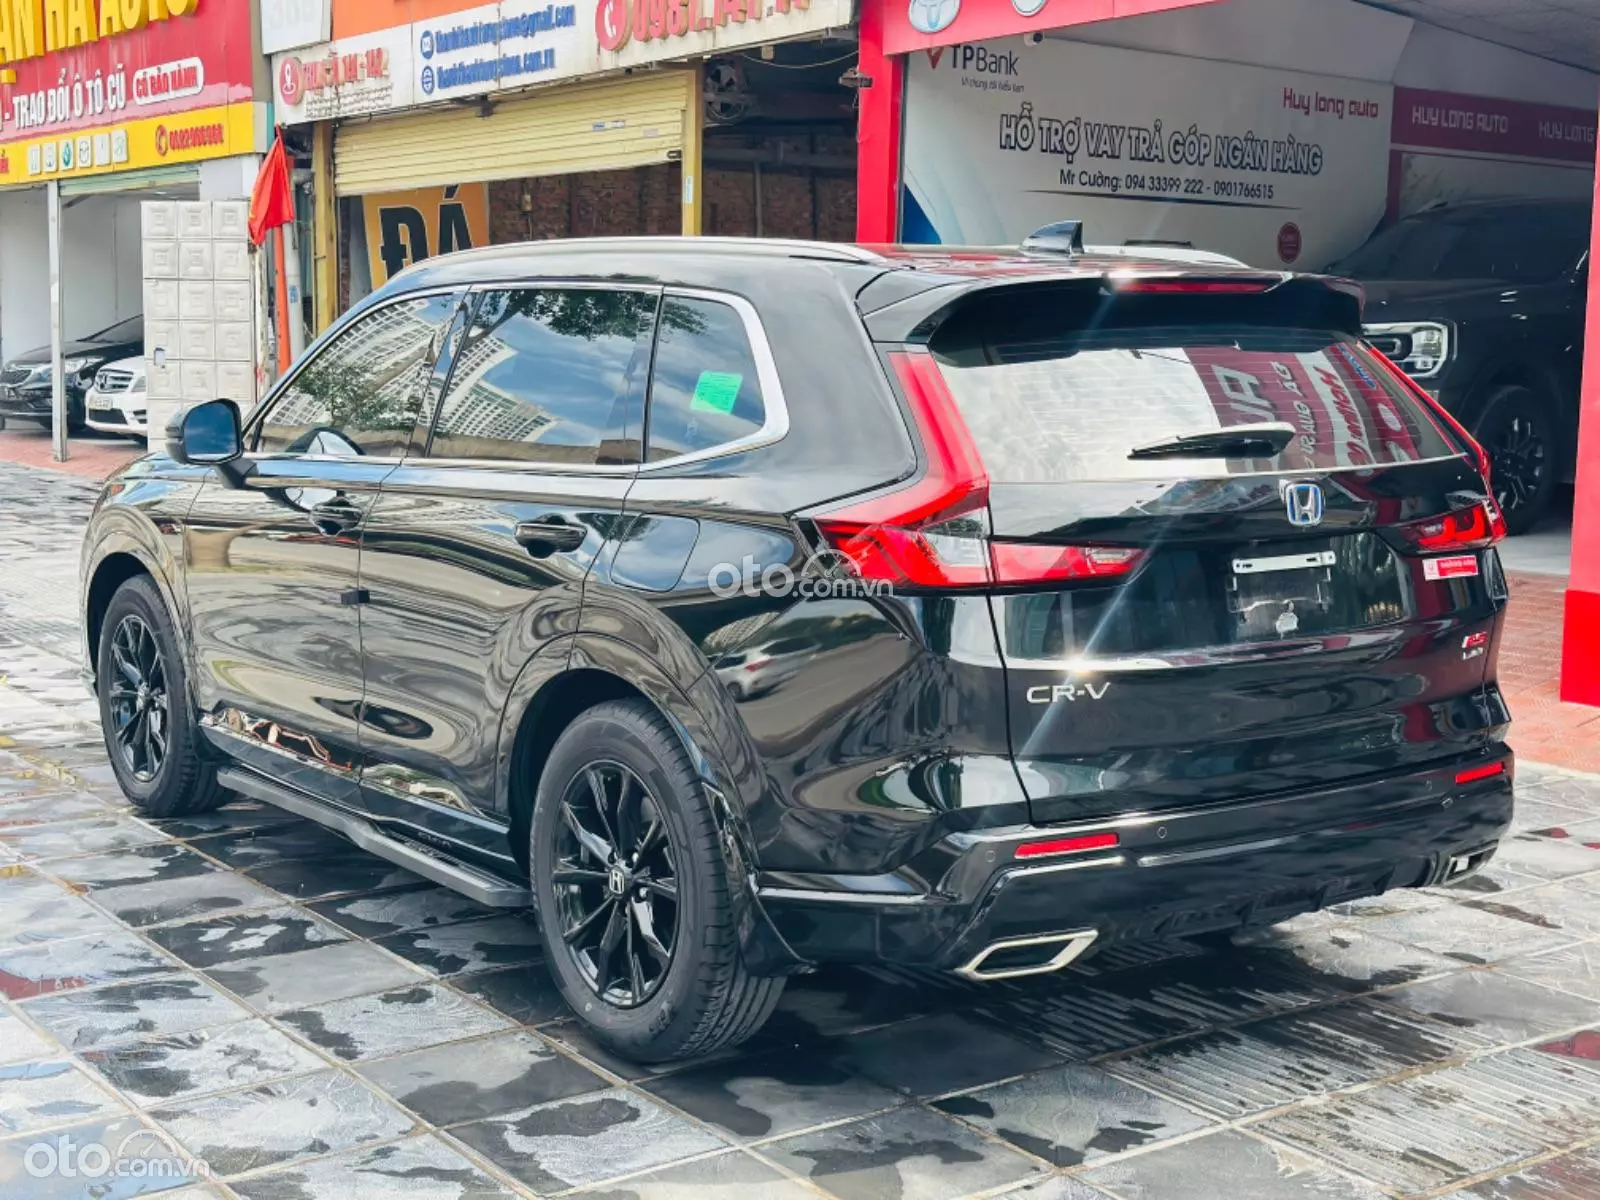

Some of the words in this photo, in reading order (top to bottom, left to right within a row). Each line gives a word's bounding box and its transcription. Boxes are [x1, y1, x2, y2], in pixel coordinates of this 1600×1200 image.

[950, 44, 1019, 76] TPBank
[12, 90, 46, 130] TRAO
[73, 72, 84, 118] Ô
[85, 68, 104, 116] TÔ
[1282, 87, 1310, 116] Huy
[1314, 91, 1345, 119] long
[1348, 98, 1379, 118] auto
[1411, 105, 1439, 126] HUY
[1441, 109, 1474, 130] LONG
[1477, 114, 1509, 134] AUTO
[1538, 120, 1563, 140] HUY
[1000, 101, 1035, 150] HỖ
[1039, 116, 1081, 164] TRỢ
[1084, 122, 1126, 159] VAY
[1128, 118, 1165, 163] TRẢ
[1168, 123, 1212, 166] GÓP
[1214, 130, 1269, 171] NGÂN
[1271, 134, 1324, 176] HÀNG
[1060, 169, 1077, 186] Mr
[1125, 174, 1146, 191] 094
[1148, 176, 1181, 194] 33399
[1183, 178, 1204, 195] 222
[1213, 179, 1275, 200] 0901766515
[1026, 681, 1111, 704] CR-V
